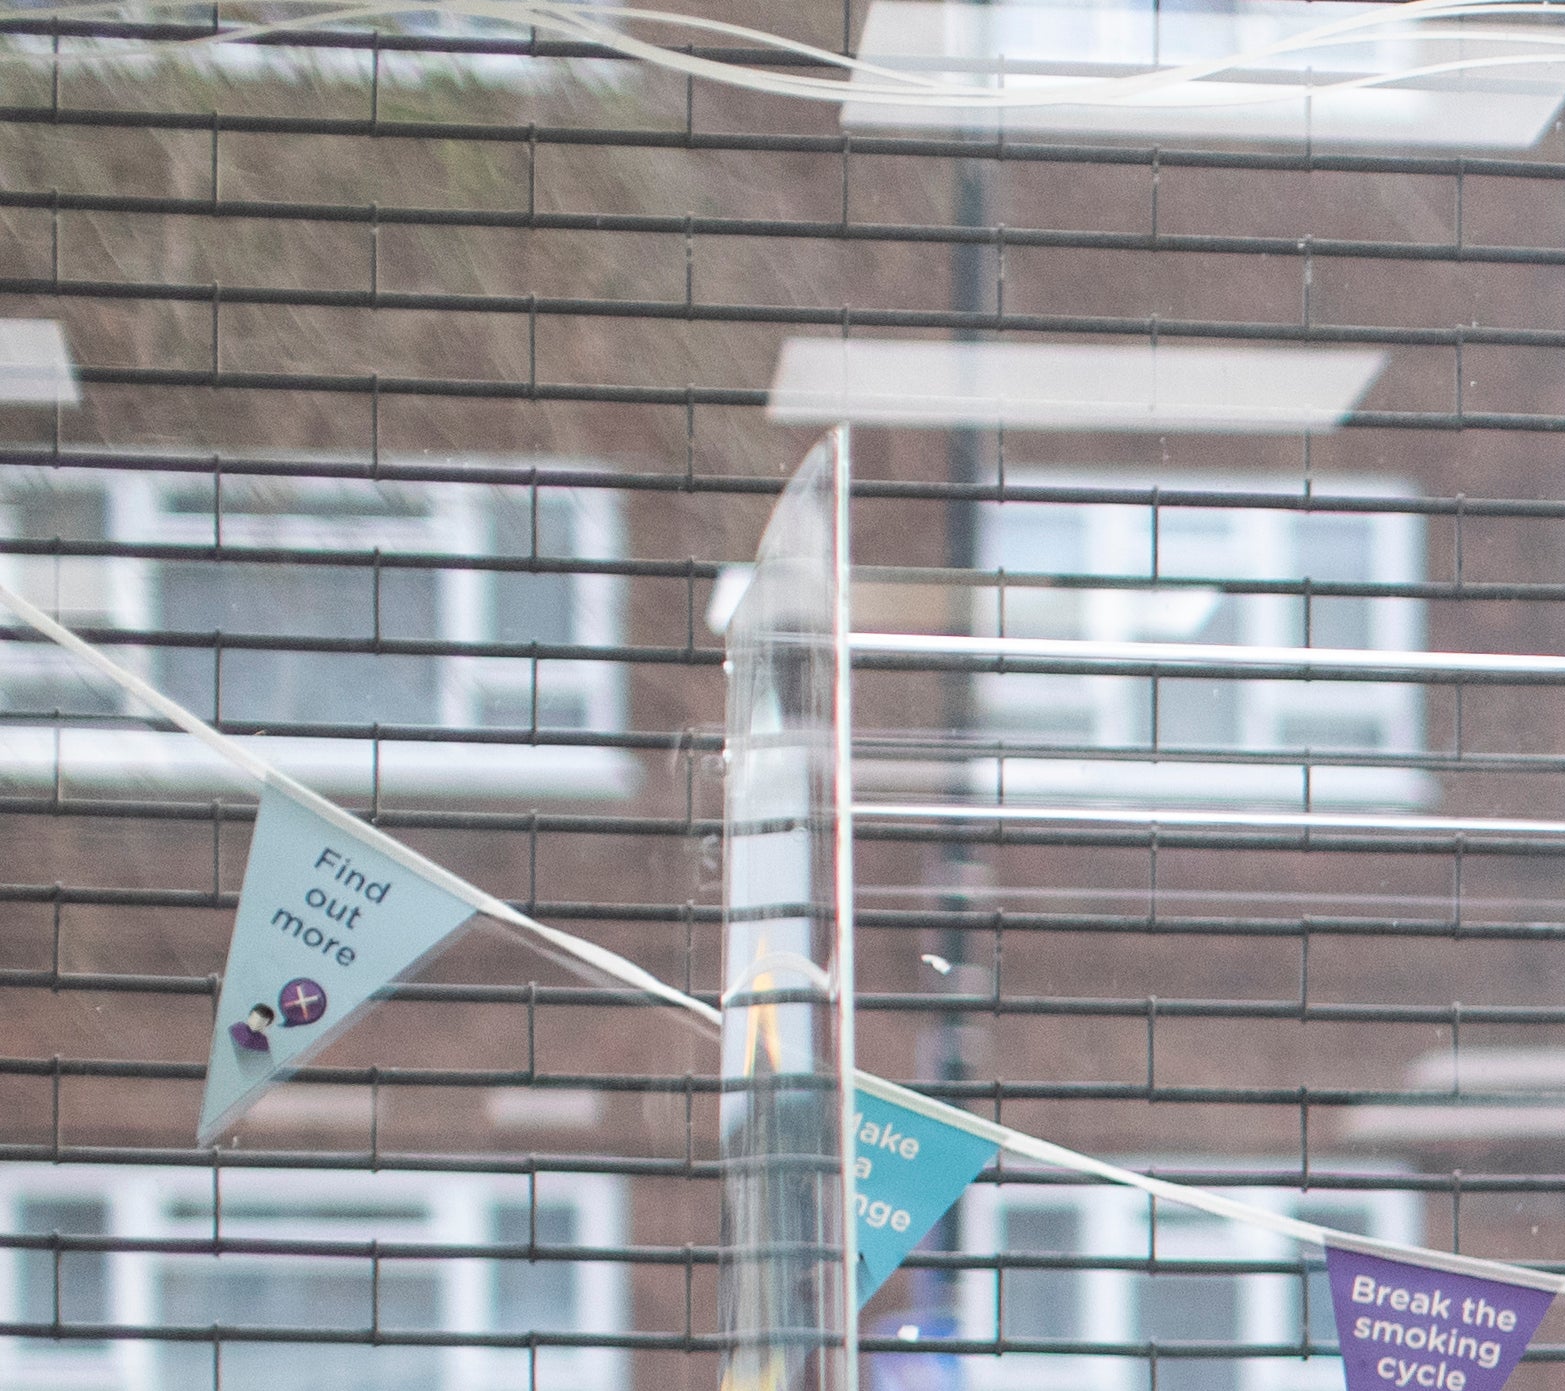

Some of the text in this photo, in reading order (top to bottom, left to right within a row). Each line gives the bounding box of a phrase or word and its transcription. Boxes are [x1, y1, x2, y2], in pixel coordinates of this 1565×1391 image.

[314, 847, 392, 904] Find
[305, 887, 361, 930] out
[270, 908, 356, 967] more
[1352, 1274, 1517, 1332] Break the
[1353, 1316, 1501, 1369] smoking
